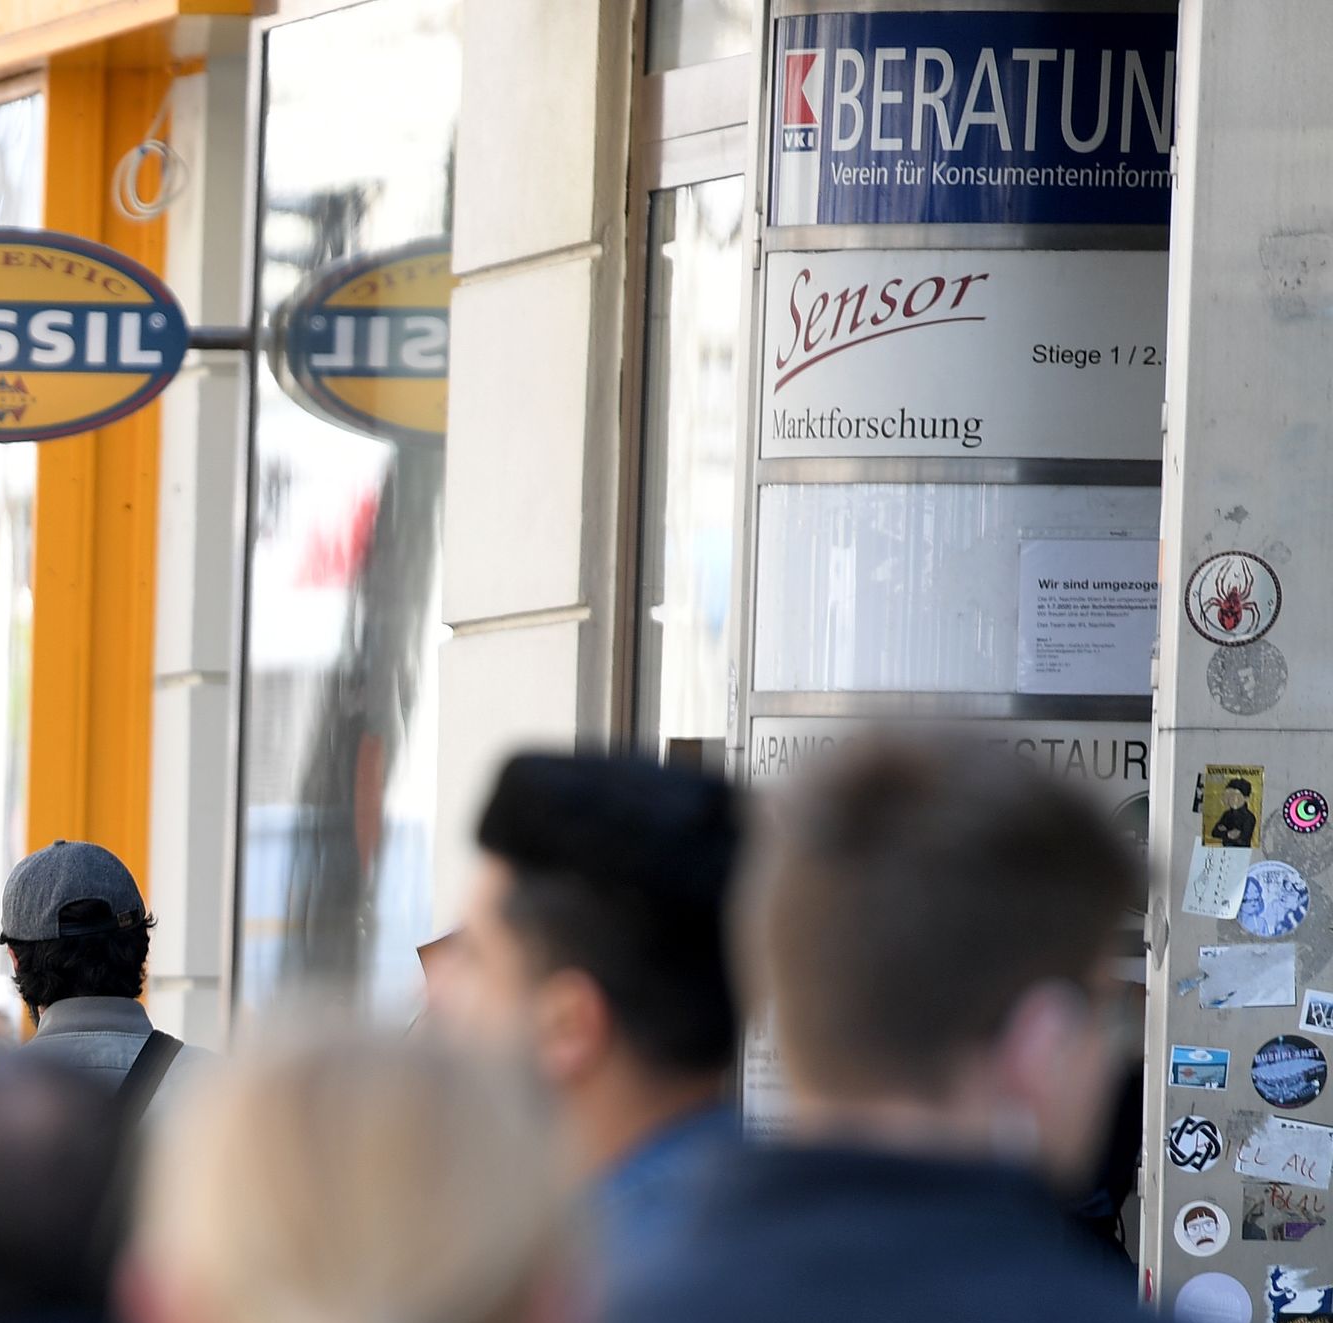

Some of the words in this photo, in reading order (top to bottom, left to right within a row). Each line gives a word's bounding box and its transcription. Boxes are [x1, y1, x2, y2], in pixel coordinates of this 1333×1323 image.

[831, 47, 1175, 154] BERATUN
[784, 131, 815, 148] VKI
[831, 161, 888, 186] Verein
[895, 159, 925, 186] für
[775, 267, 990, 371] Sensor
[1032, 344, 1101, 369] Stiege
[1111, 345, 1119, 365] 1
[772, 406, 984, 448] Marktforschung
[1038, 579, 1059, 590] Wir
[1063, 579, 1089, 590] sind
